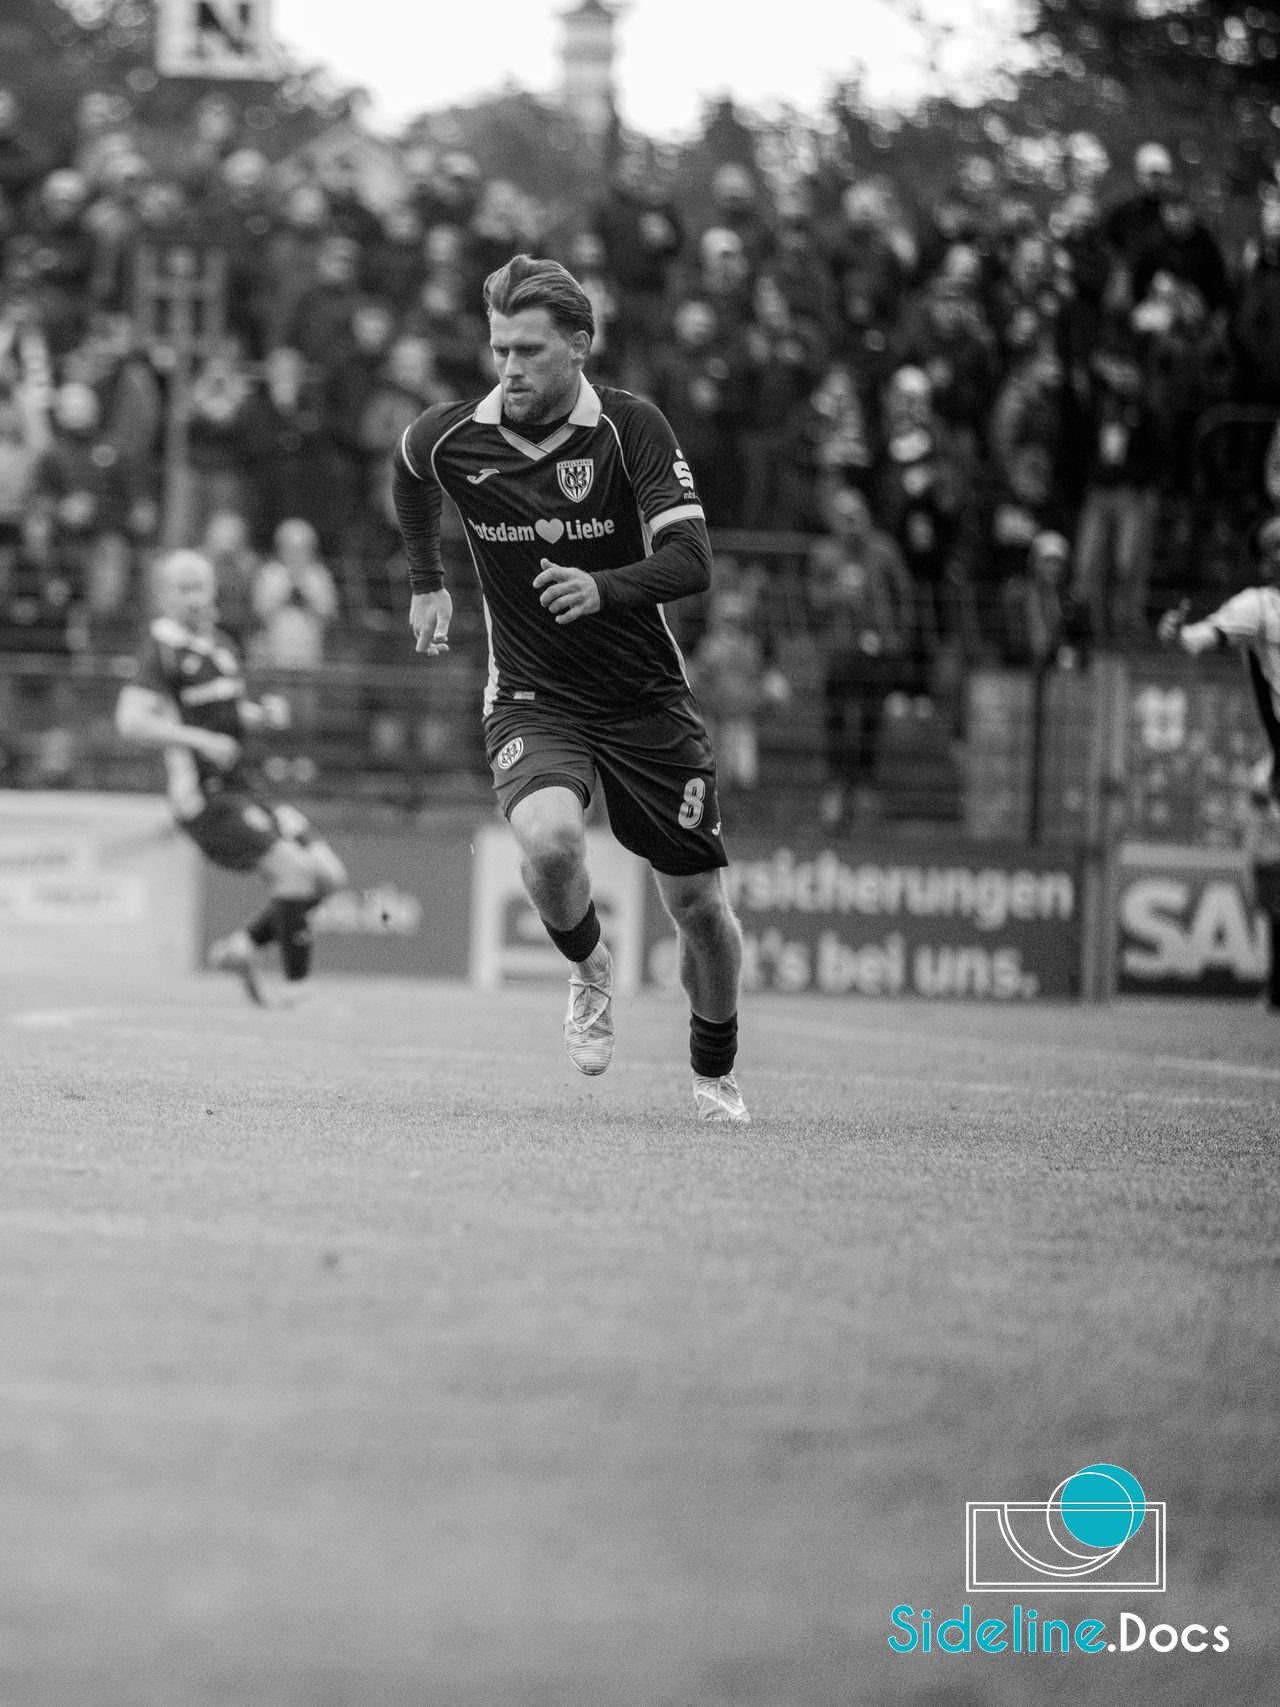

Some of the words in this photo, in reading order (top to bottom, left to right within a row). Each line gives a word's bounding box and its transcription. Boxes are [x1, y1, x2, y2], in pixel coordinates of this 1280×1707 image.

[468, 518, 536, 542] otsdam
[566, 517, 615, 541] Liebe
[678, 777, 706, 829] 8
[723, 848, 1075, 929] rsicherungen
[820, 930, 906, 991] bei
